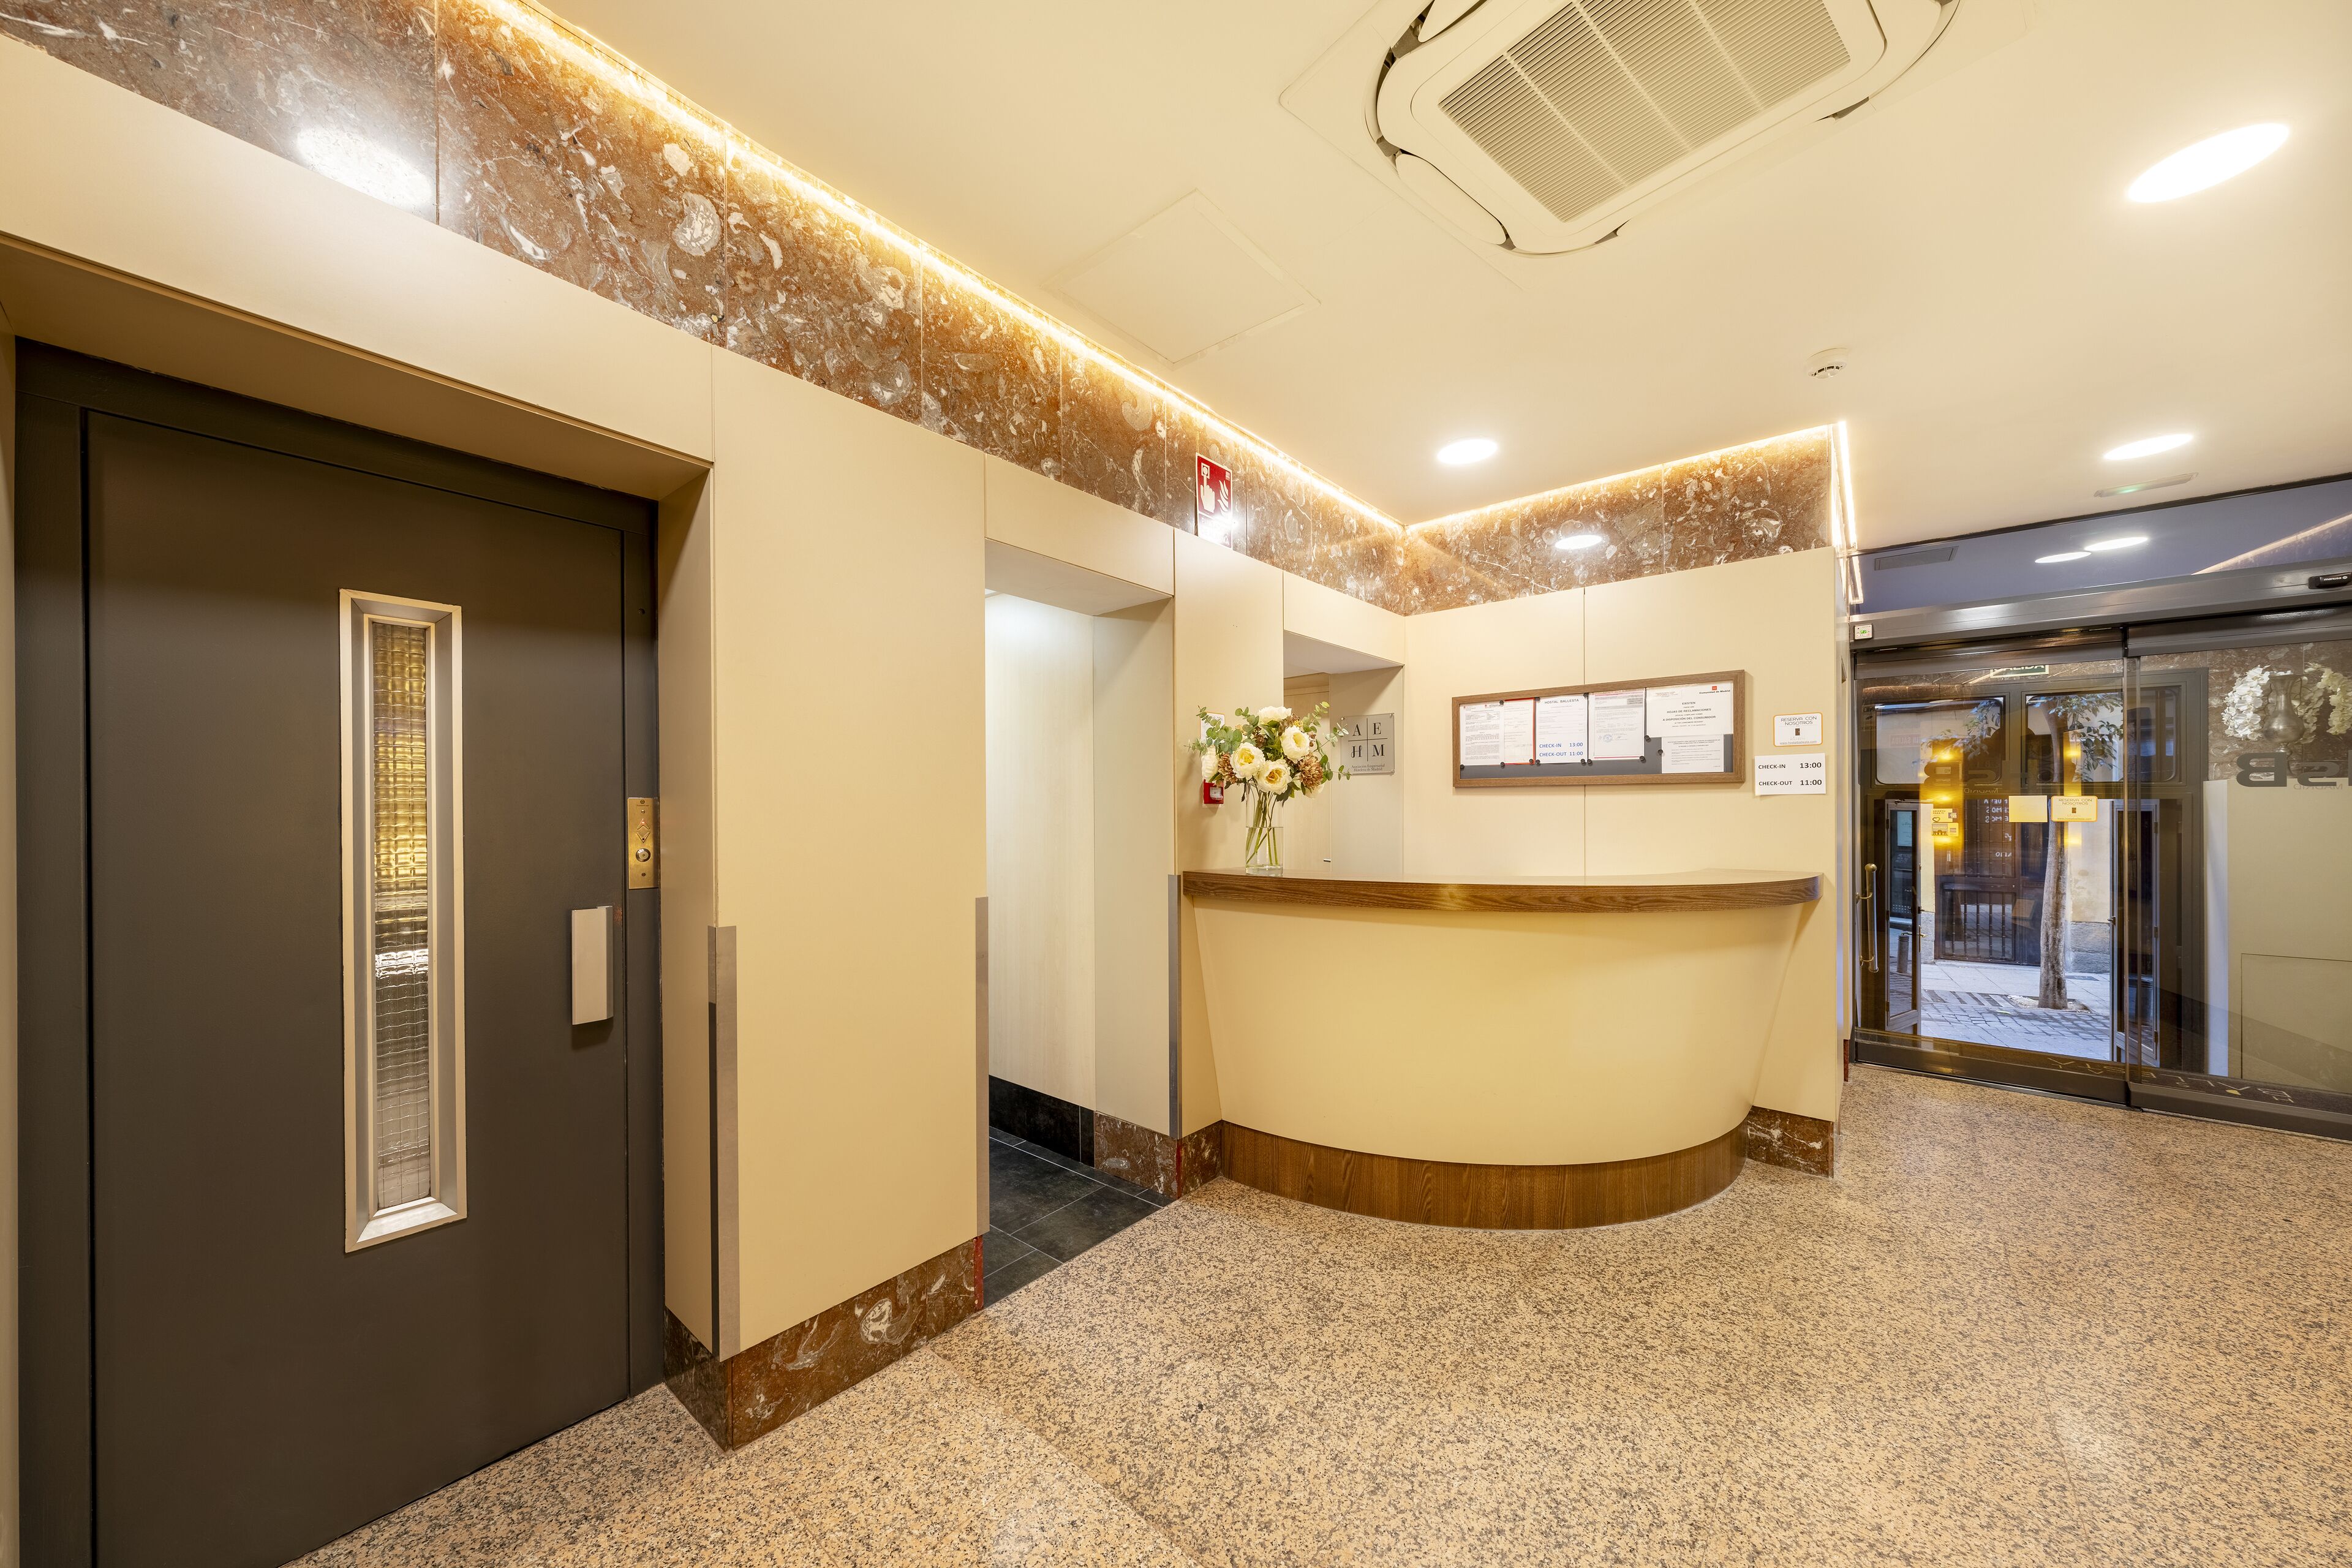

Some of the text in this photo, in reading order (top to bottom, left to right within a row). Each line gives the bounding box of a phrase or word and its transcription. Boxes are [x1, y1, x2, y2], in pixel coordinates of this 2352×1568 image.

[1352, 723, 1381, 736] A E
[1351, 744, 1385, 758] H M
